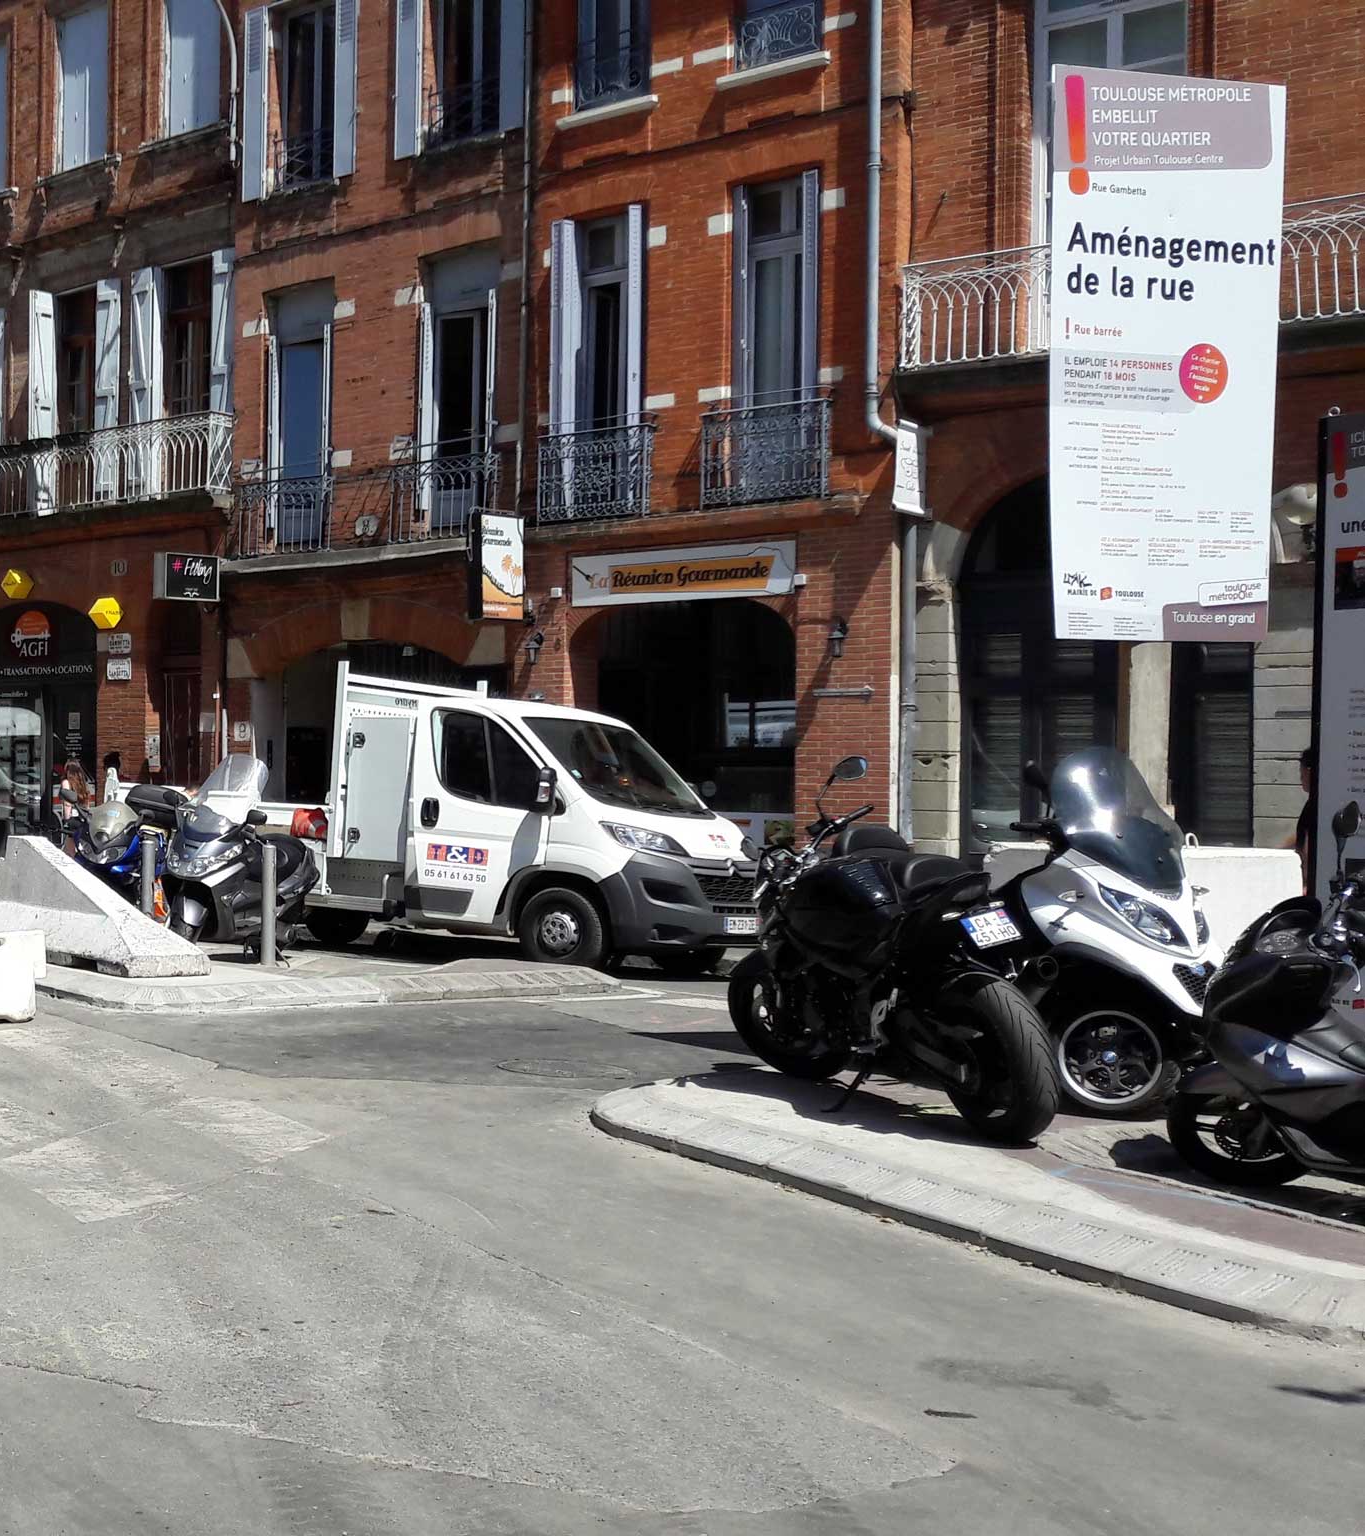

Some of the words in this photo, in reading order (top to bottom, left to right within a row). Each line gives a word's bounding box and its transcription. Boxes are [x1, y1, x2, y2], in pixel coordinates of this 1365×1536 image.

[1091, 87, 1165, 101] TOULOUSE
[1169, 84, 1251, 102] MÉTROPOLE
[1092, 109, 1158, 123] EMBELLIT
[1093, 132, 1137, 146] VOTRE
[1141, 132, 1211, 146] QUARTIER
[1094, 156, 1120, 166] Projet
[1123, 155, 1151, 165] Urbain
[1154, 154, 1193, 164] Toulouse
[1195, 154, 1224, 164] Centre
[1092, 183, 1107, 193] Rue
[1109, 185, 1146, 196] Gambetta
[1067, 222, 1276, 268] Aménagement
[1067, 263, 1099, 294] de
[1112, 267, 1134, 298] la
[1147, 276, 1195, 301] rue
[1074, 324, 1091, 335] Rue
[1093, 326, 1122, 337] barrée
[1074, 356, 1108, 367] EMPLOIE
[1110, 359, 1118, 368] 14
[1121, 360, 1173, 370] PERSONNES
[1064, 369, 1102, 379] PENDANT
[1115, 372, 1136, 381] MOIS
[613, 566, 674, 588] Réunion
[1115, 590, 1144, 598] TOULOUSE
[1171, 610, 1213, 624] Toulouse
[1215, 614, 1227, 623] en
[1228, 611, 1256, 626] grand
[19, 641, 48, 657] AGFI
[4, 666, 51, 676] TRANSACTIONS
[54, 664, 93, 674] LOCATIONS
[424, 868, 436, 878] 05
[437, 870, 447, 879] 61
[450, 871, 460, 880] 61
[462, 873, 474, 882] 63
[475, 874, 487, 883] 50
